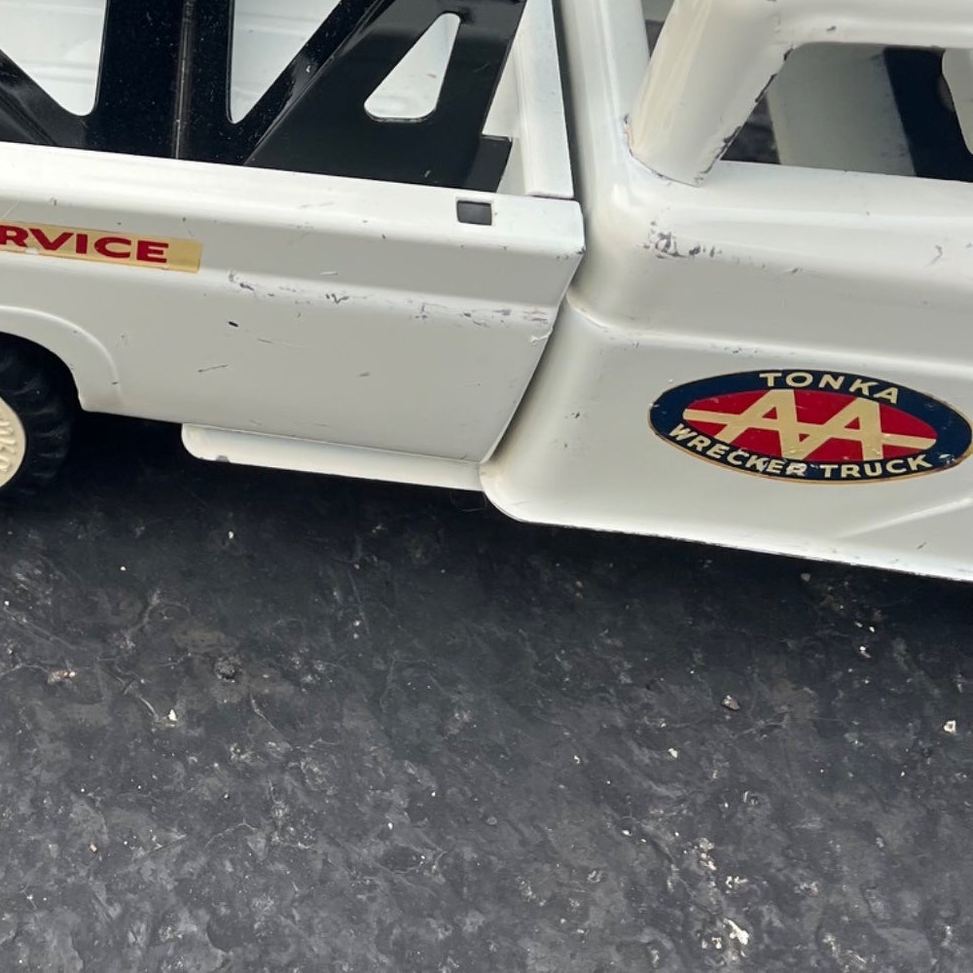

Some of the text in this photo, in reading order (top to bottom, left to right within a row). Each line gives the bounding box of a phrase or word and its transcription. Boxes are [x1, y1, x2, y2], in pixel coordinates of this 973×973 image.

[759, 372, 899, 405] TONKA
[668, 423, 933, 479] WRECKER TRUCK
[713, 388, 884, 461] AA
